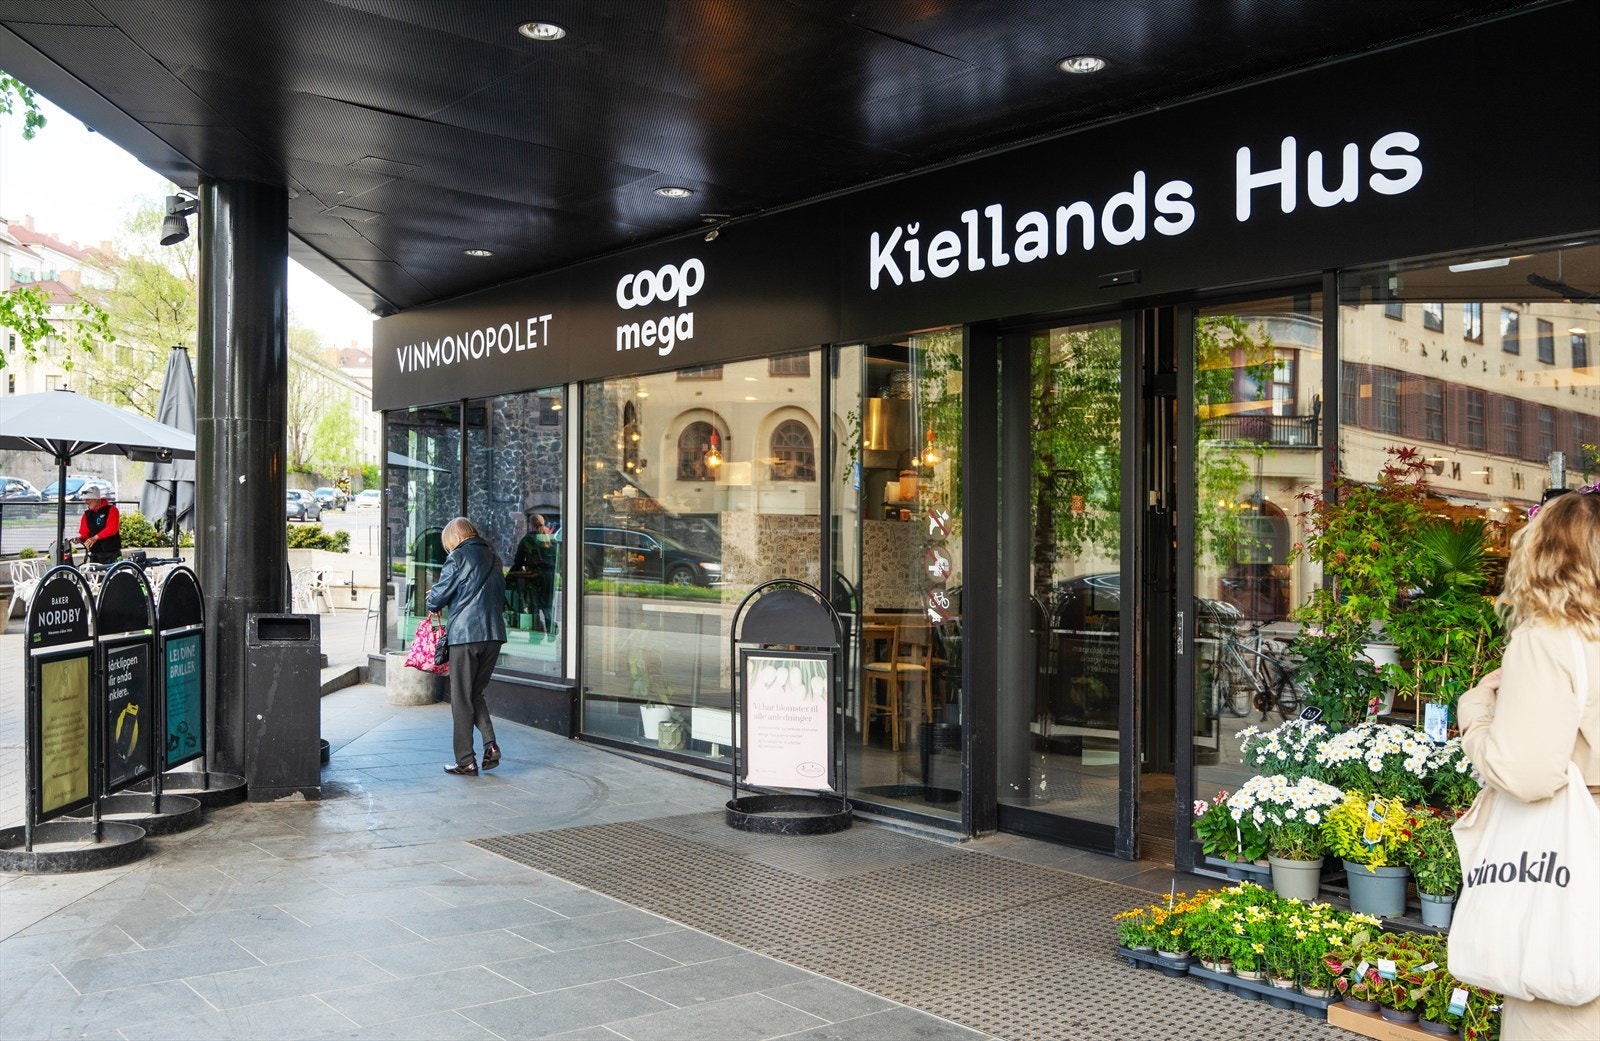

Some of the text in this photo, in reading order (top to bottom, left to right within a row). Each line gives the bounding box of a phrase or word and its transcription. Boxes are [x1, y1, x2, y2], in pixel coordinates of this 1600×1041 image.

[869, 131, 1423, 291] Kiellands Hus
[616, 257, 705, 310] coop
[396, 313, 553, 374] VINMONOPOLET
[616, 311, 694, 357] mega
[51, 596, 69, 606] BAKER
[38, 607, 81, 627] NORDBY
[117, 670, 132, 684] enda
[170, 660, 196, 679] BRILLER
[753, 702, 818, 713] Vi har blomster til
[754, 712, 812, 723] alle anledninger
[1467, 850, 1571, 888] vinokilo
